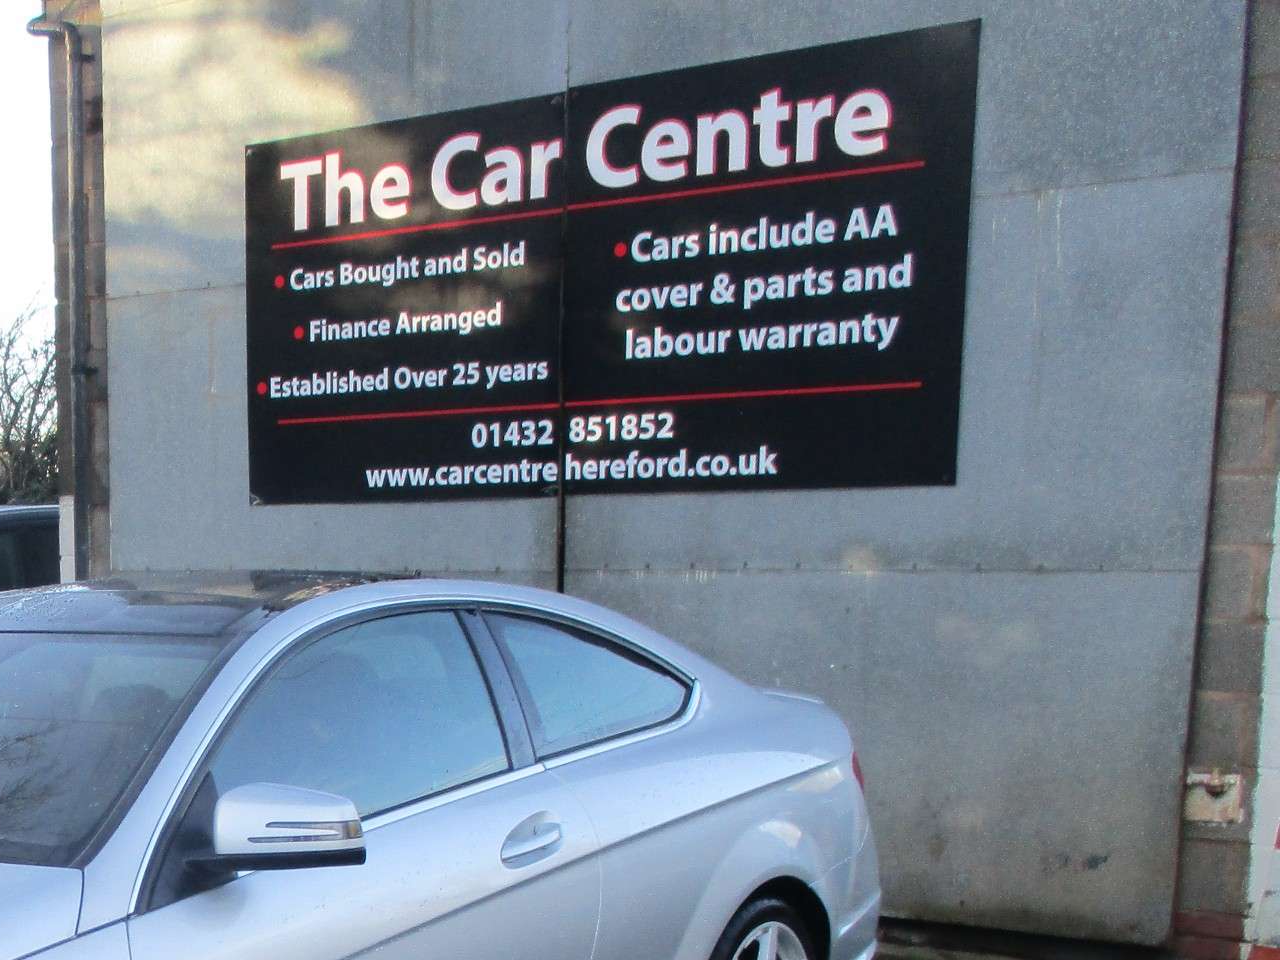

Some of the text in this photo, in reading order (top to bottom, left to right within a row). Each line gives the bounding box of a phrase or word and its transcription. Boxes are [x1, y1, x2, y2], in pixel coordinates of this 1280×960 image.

[279, 88, 893, 232] The Car Centre
[631, 203, 899, 263] Cars include AA
[289, 240, 526, 291] Cars Bought and Sold
[615, 253, 913, 312] cover & parts and
[309, 302, 503, 343] Finance Arranged
[625, 313, 900, 360] labour warranty
[269, 360, 549, 399] Established Over 25 years
[470, 412, 675, 449] 01432 851852
[365, 445, 778, 488] www.carcentrehereford.co.uk
